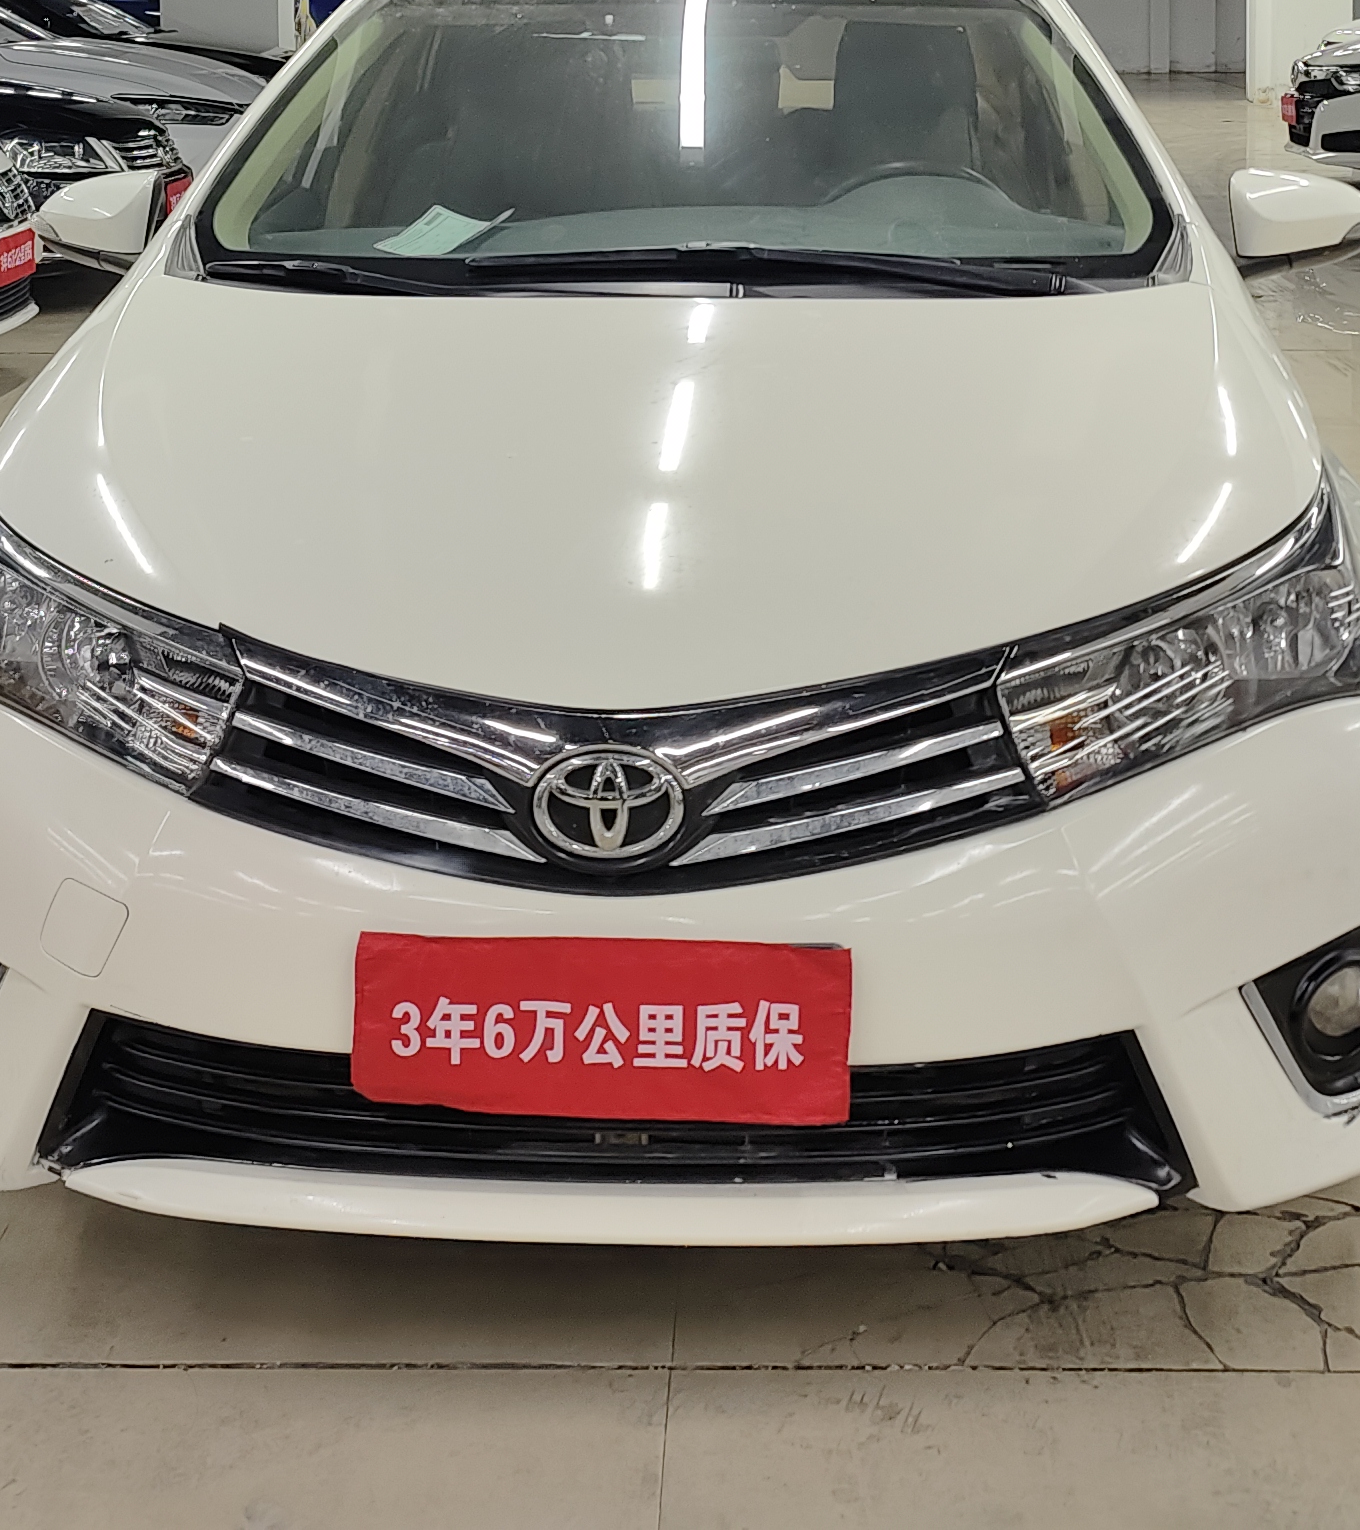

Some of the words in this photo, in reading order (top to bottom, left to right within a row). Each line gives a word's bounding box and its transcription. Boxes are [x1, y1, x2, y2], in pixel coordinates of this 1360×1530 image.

[390, 996, 805, 1072] 3年6万公里质保
